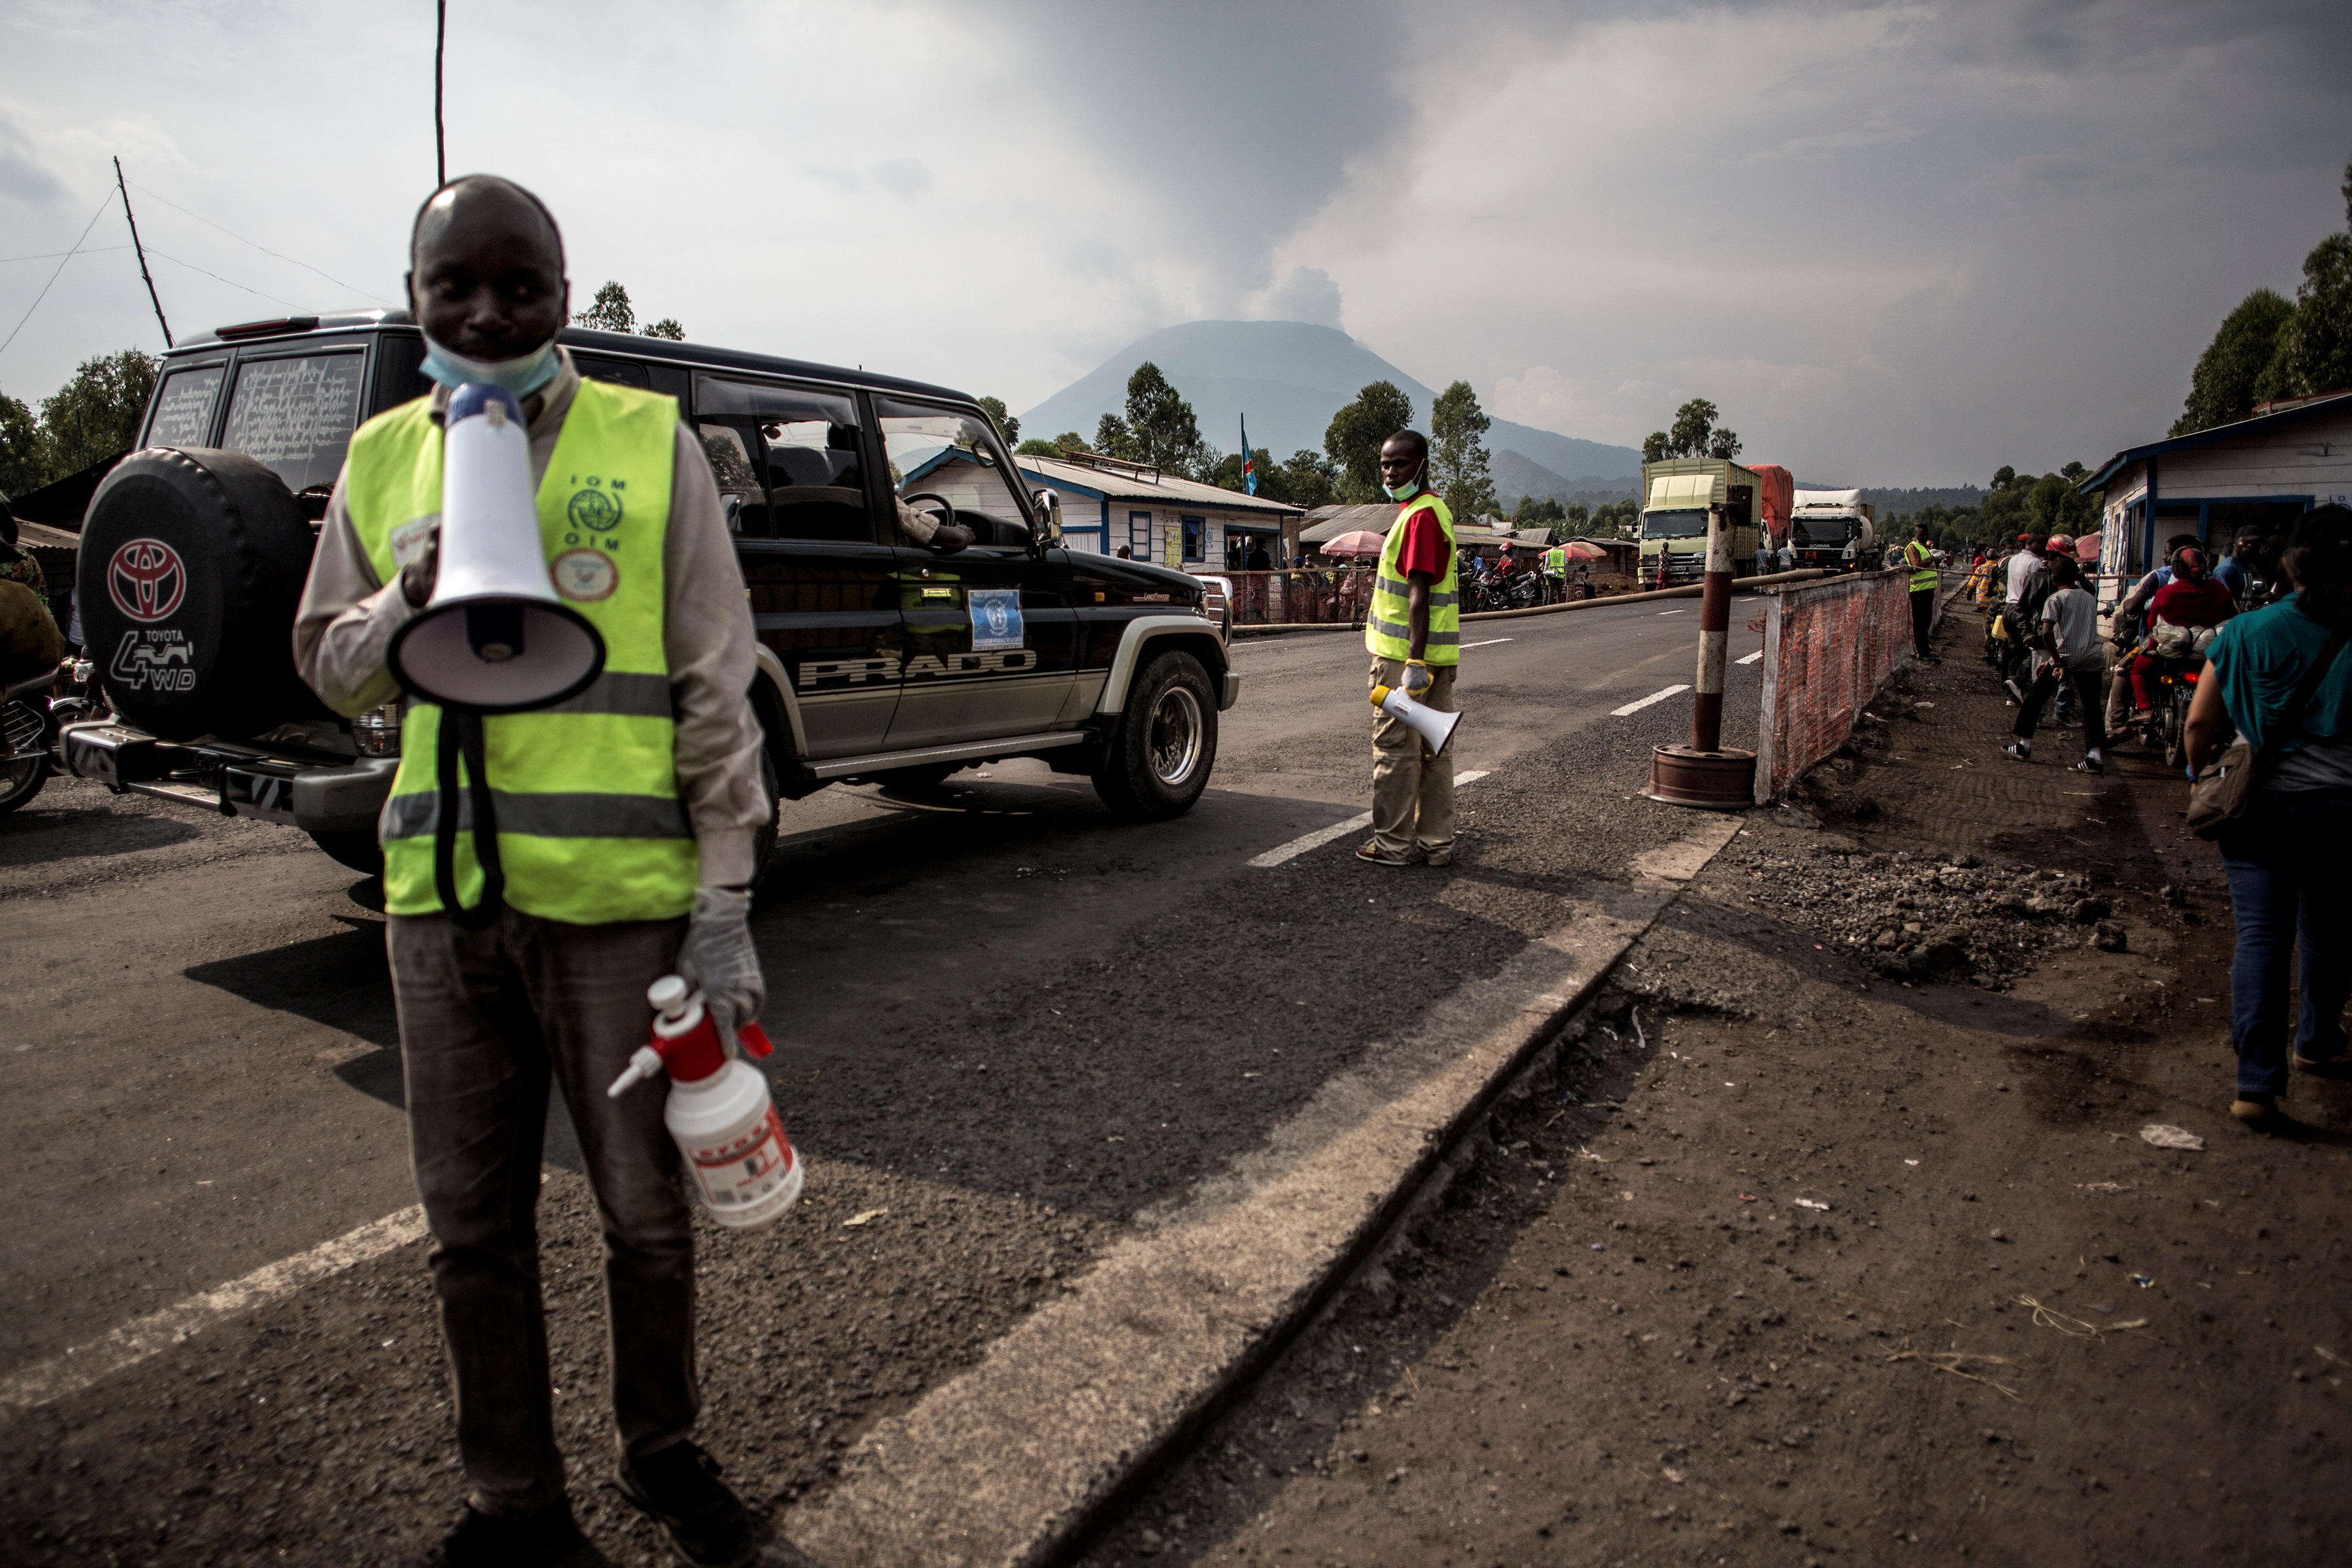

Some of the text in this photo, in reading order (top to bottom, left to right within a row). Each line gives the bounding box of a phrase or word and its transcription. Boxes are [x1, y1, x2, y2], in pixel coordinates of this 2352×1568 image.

[570, 474, 626, 491] IOM
[564, 532, 620, 551] OIM
[146, 630, 184, 642] TOYOTA
[799, 650, 1037, 685] PRADO
